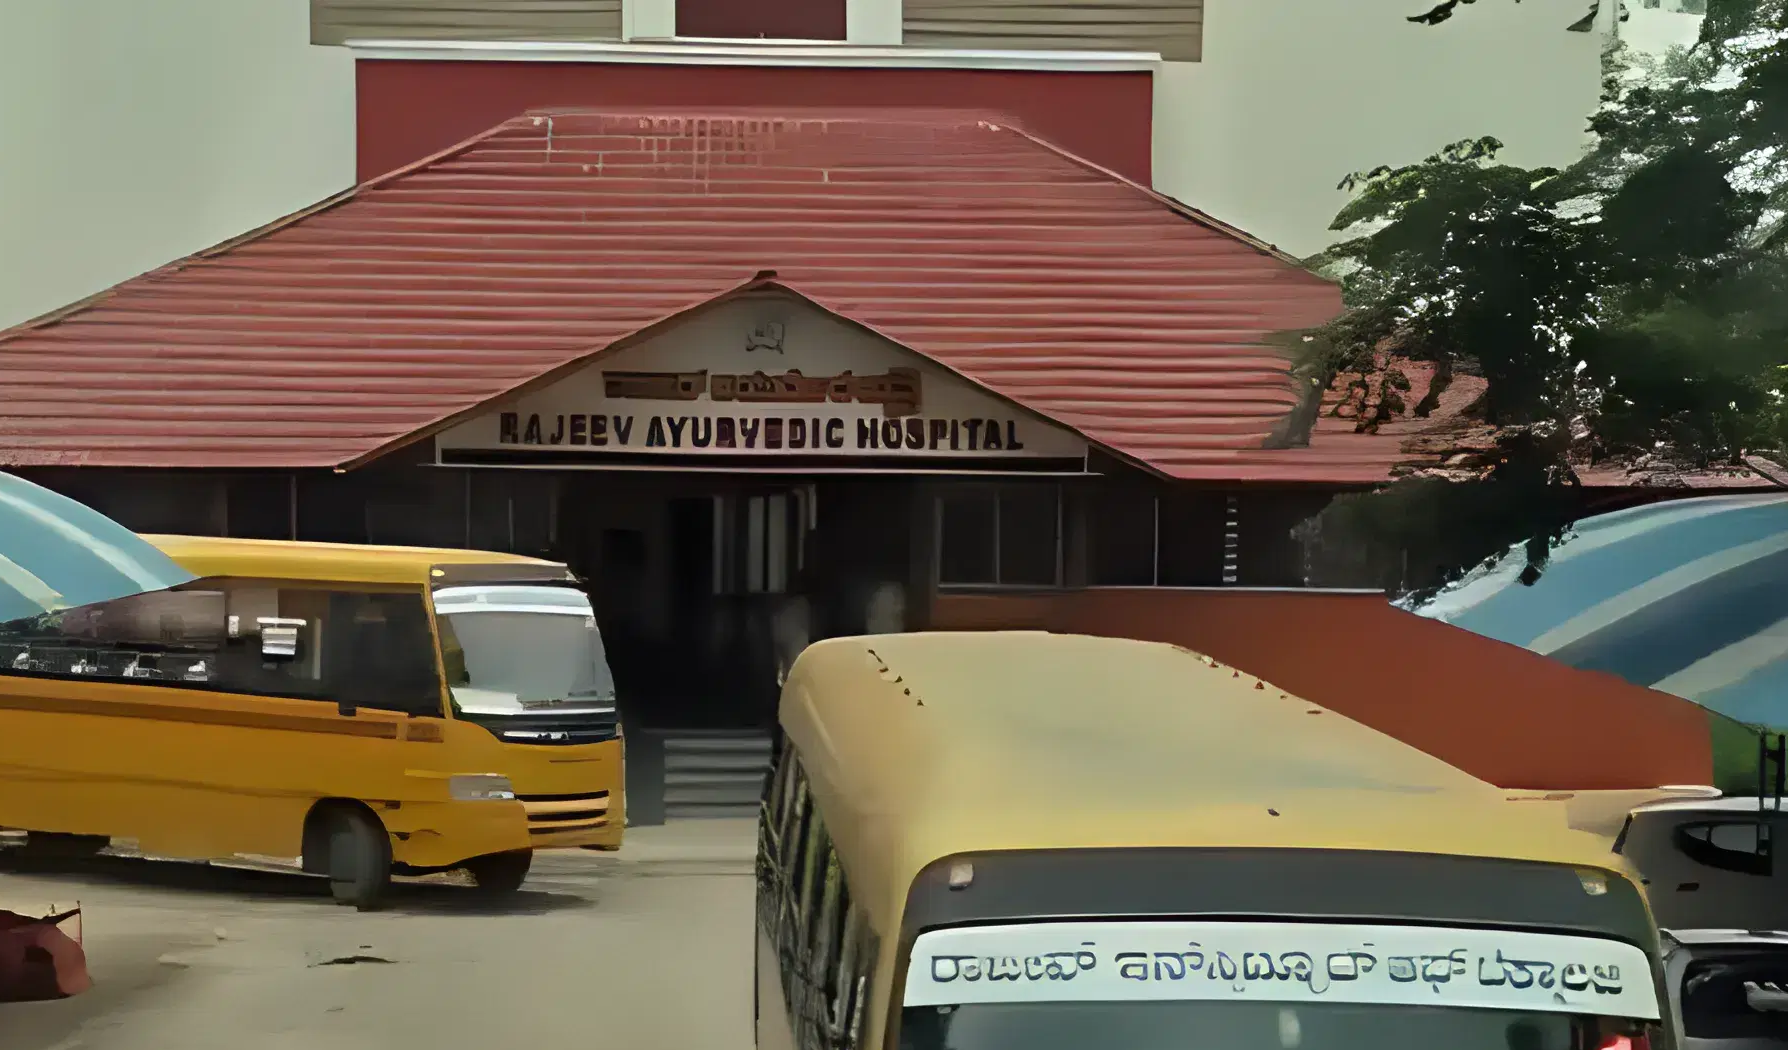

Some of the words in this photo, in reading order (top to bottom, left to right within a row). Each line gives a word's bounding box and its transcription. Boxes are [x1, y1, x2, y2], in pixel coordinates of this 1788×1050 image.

[500, 412, 634, 447] RAJEEV
[645, 415, 844, 449] AYURVEDIC
[857, 417, 1024, 451] HOSPITAL
